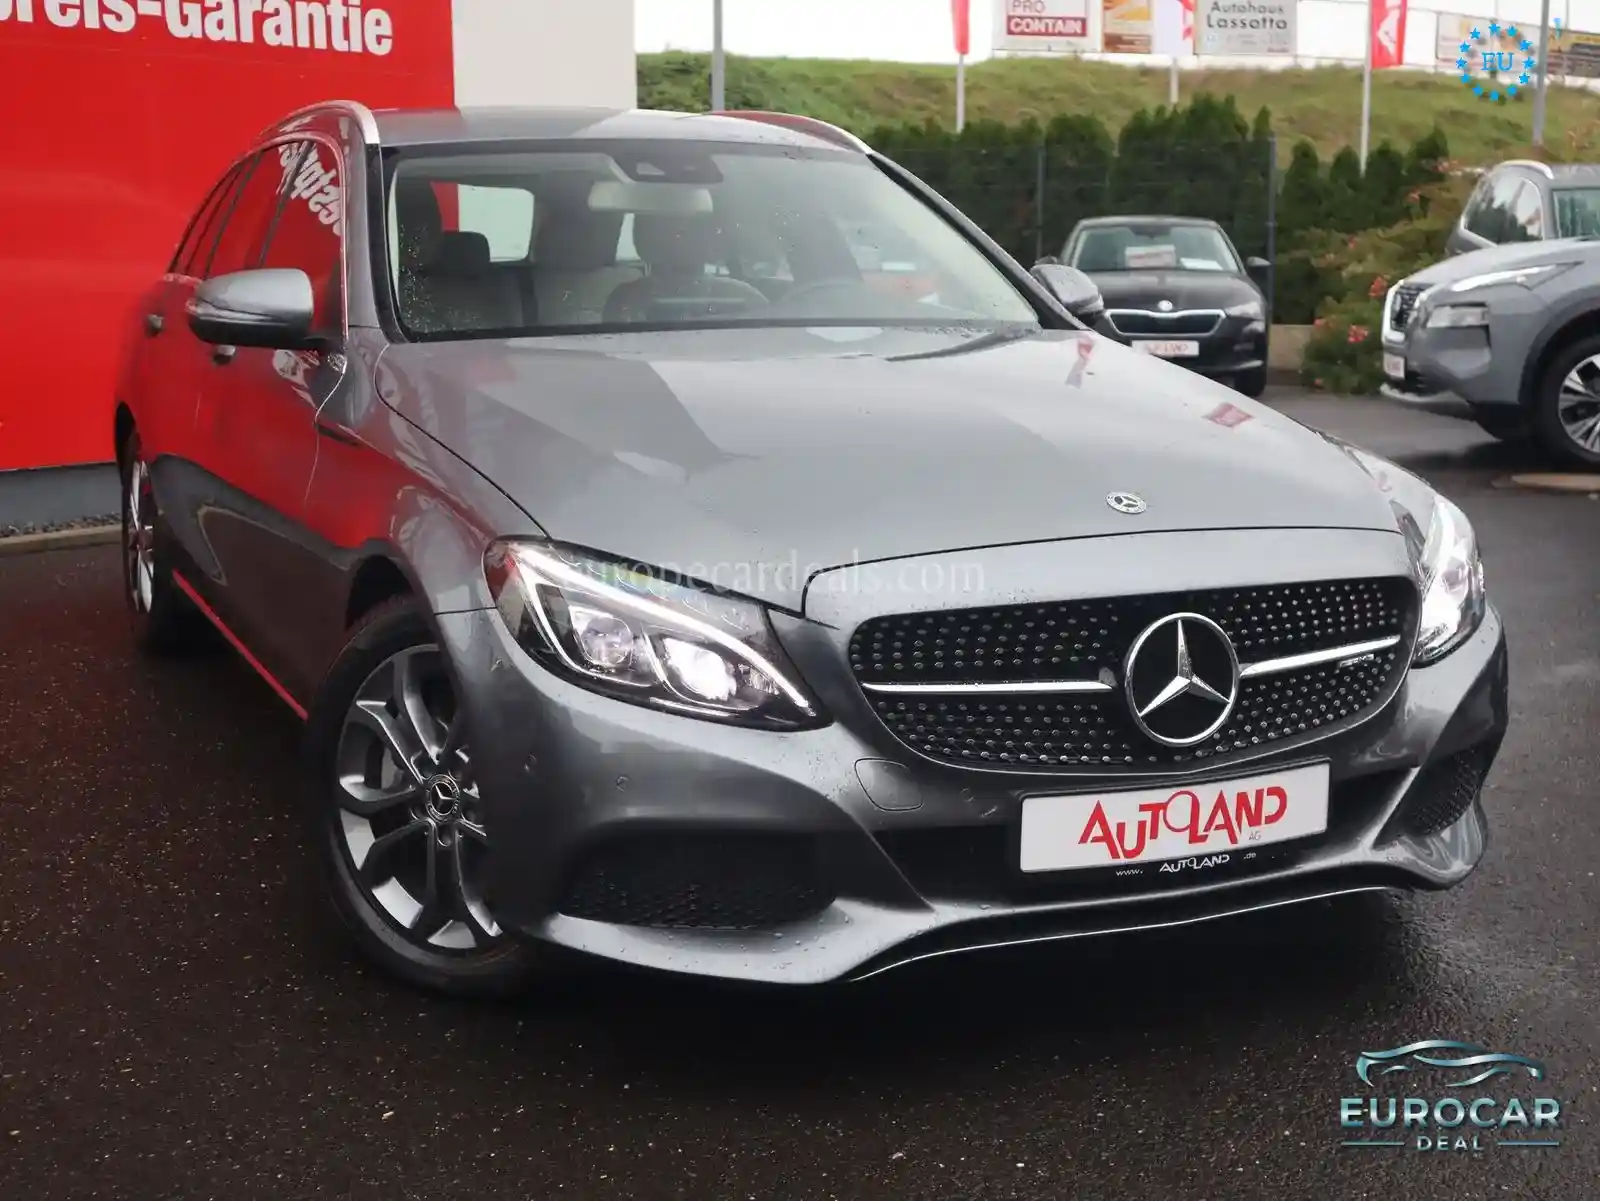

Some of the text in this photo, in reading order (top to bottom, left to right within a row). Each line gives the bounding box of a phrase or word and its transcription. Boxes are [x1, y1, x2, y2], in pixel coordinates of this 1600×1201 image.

[1013, 0, 1046, 13] PRO
[1211, 1, 1284, 14] Autohaus
[1010, 18, 1082, 33] CONTAIN
